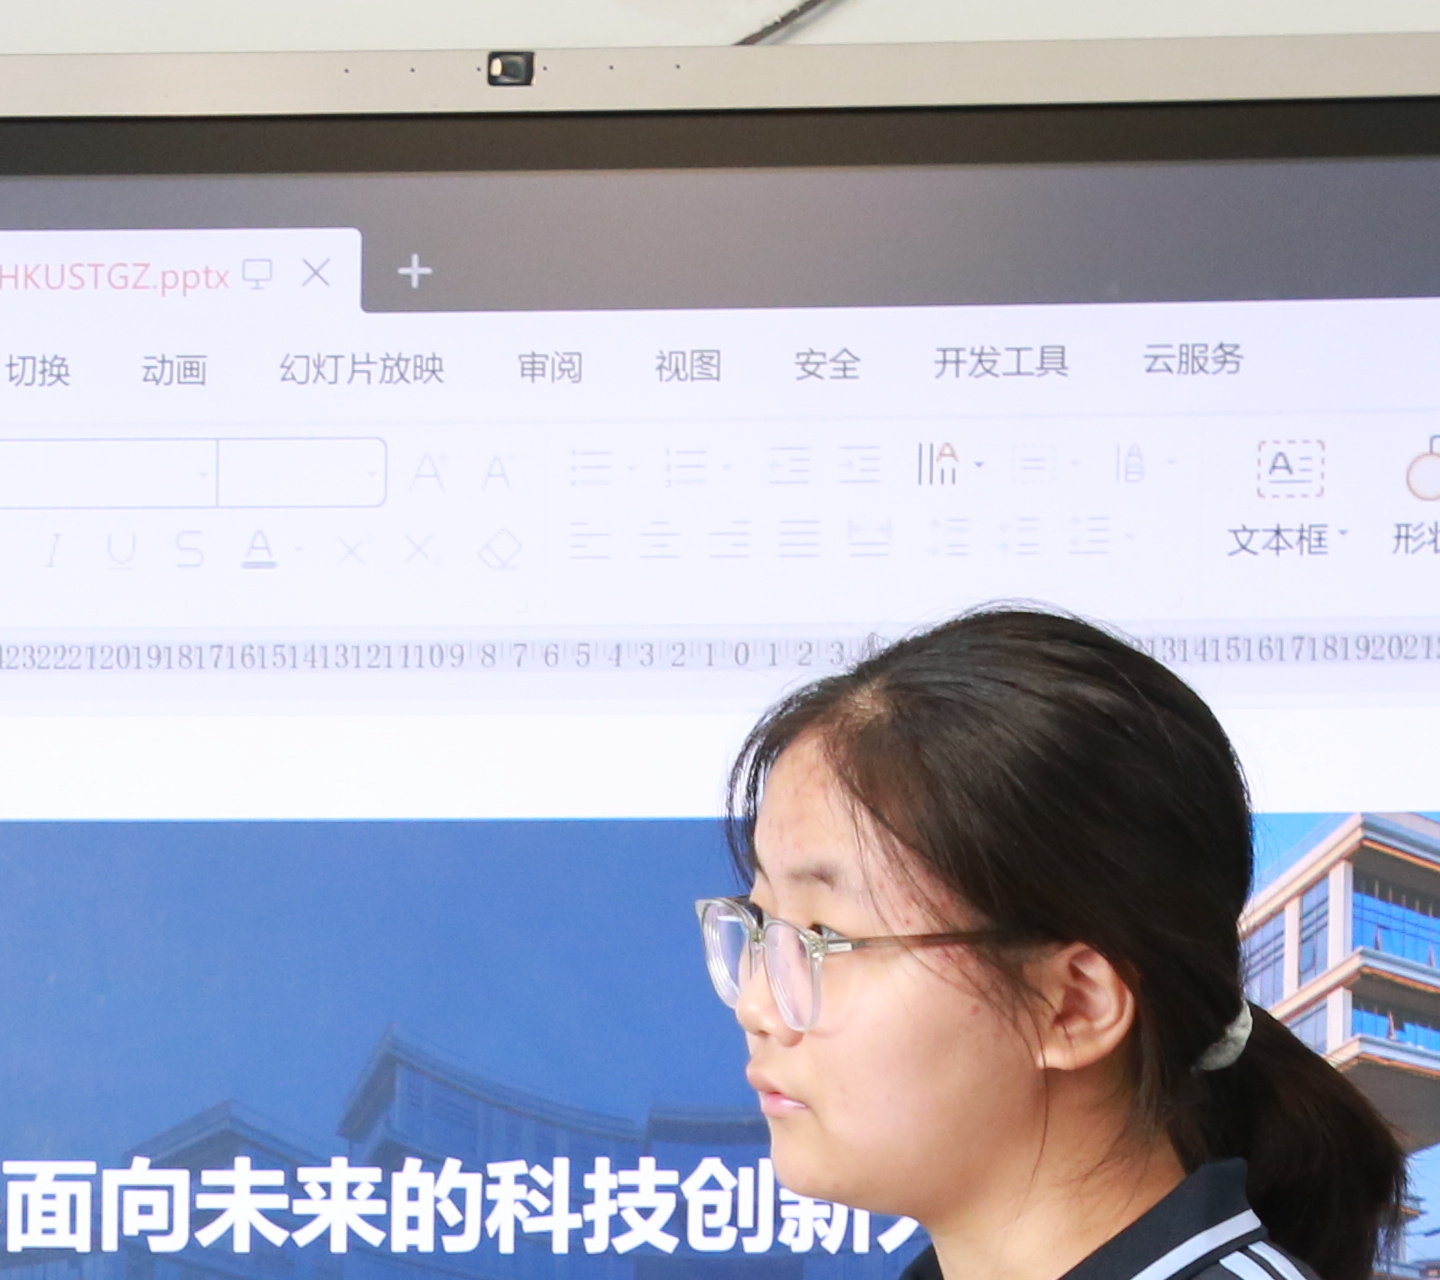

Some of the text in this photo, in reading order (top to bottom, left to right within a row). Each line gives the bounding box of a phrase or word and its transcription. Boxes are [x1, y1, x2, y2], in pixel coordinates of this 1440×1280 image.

[5, 354, 72, 388] 切换
[141, 353, 208, 387] 动画
[278, 351, 445, 386] 幻灯片放映
[517, 351, 583, 385] 审阅
[654, 350, 721, 384] 视图
[794, 348, 861, 382] 安全
[933, 345, 1070, 380] 开发工具
[1142, 341, 1245, 376] 云服务
[1226, 523, 1329, 558] 文本框
